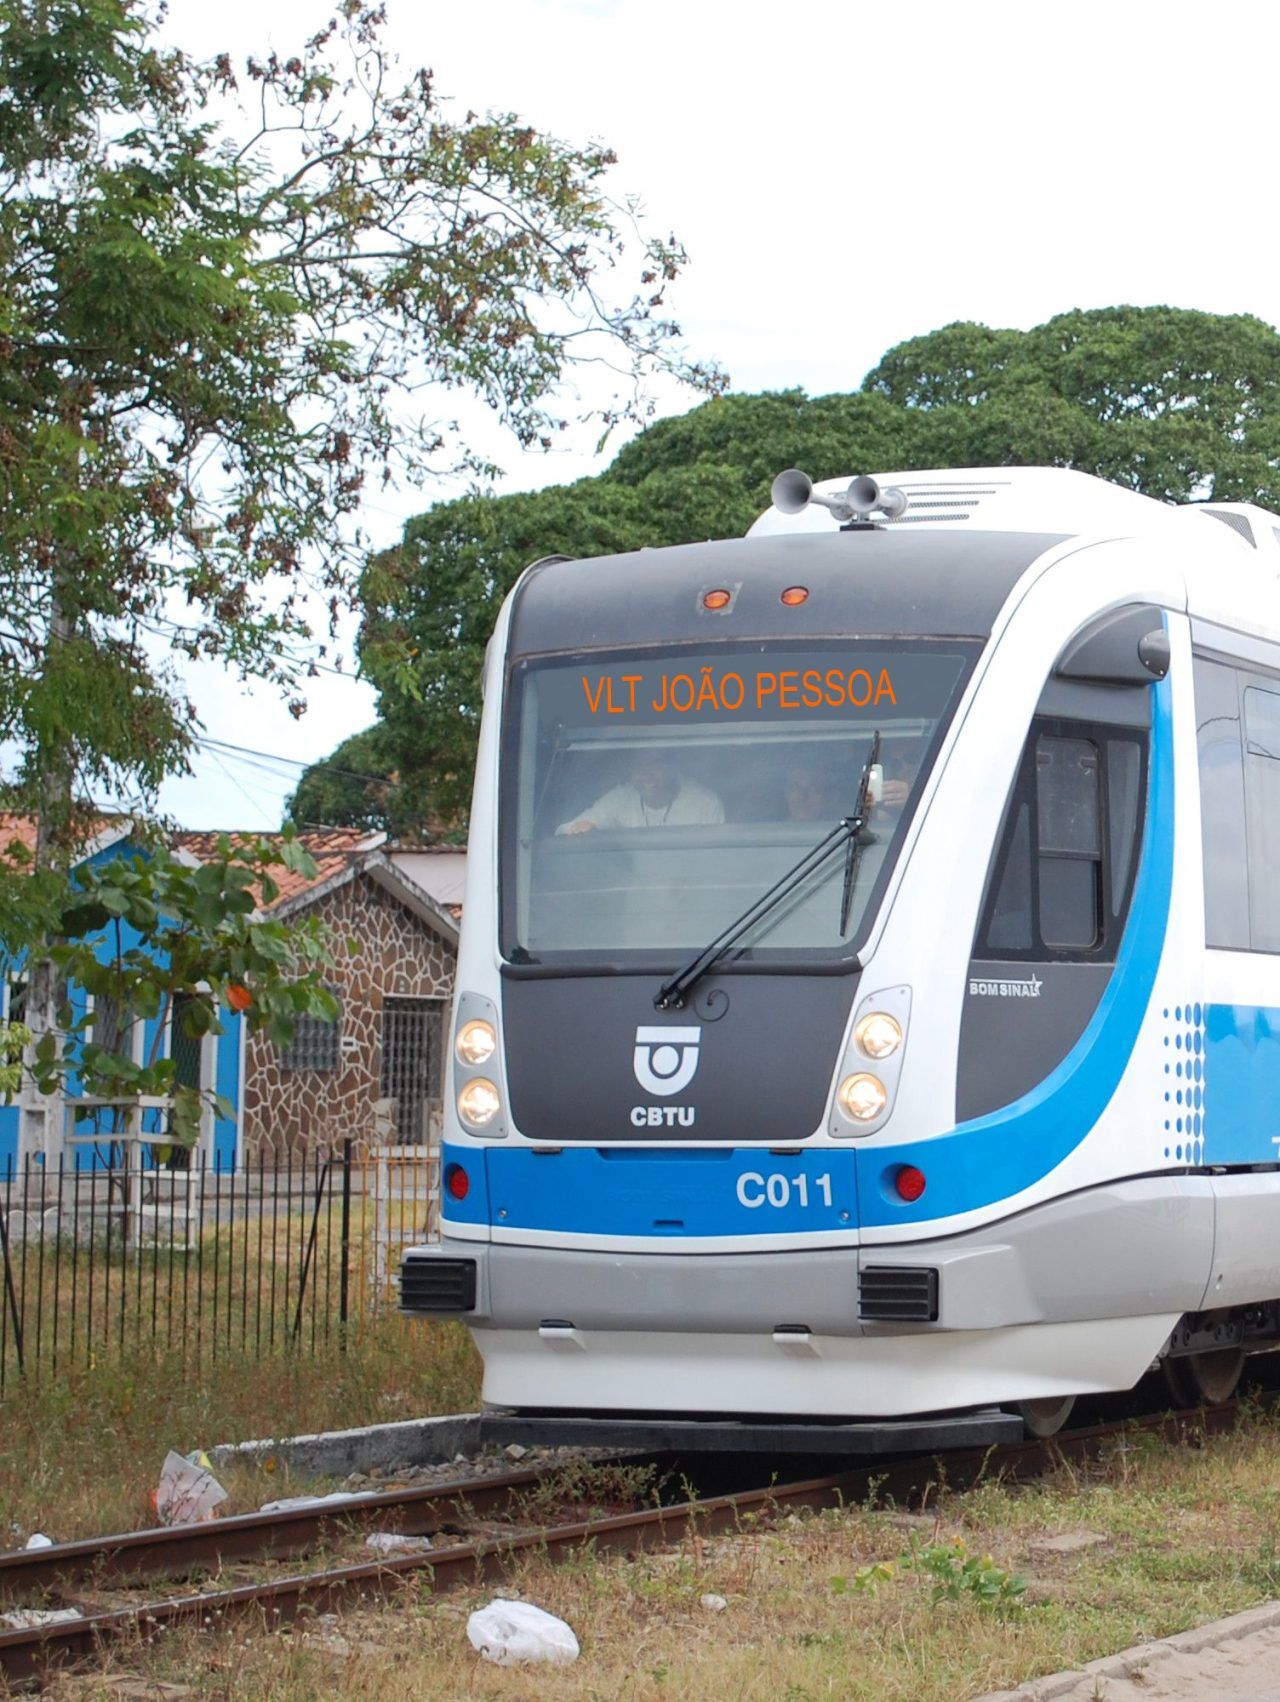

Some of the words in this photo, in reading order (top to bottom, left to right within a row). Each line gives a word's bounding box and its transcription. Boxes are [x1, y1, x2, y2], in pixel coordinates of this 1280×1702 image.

[582, 675, 642, 713] VLT
[652, 667, 745, 712] JOÃO
[756, 668, 897, 709] PESSOA
[969, 983, 998, 996] BOM
[999, 983, 1039, 997] SINAL
[631, 1106, 695, 1127] CBTU
[736, 1172, 832, 1208] C011
